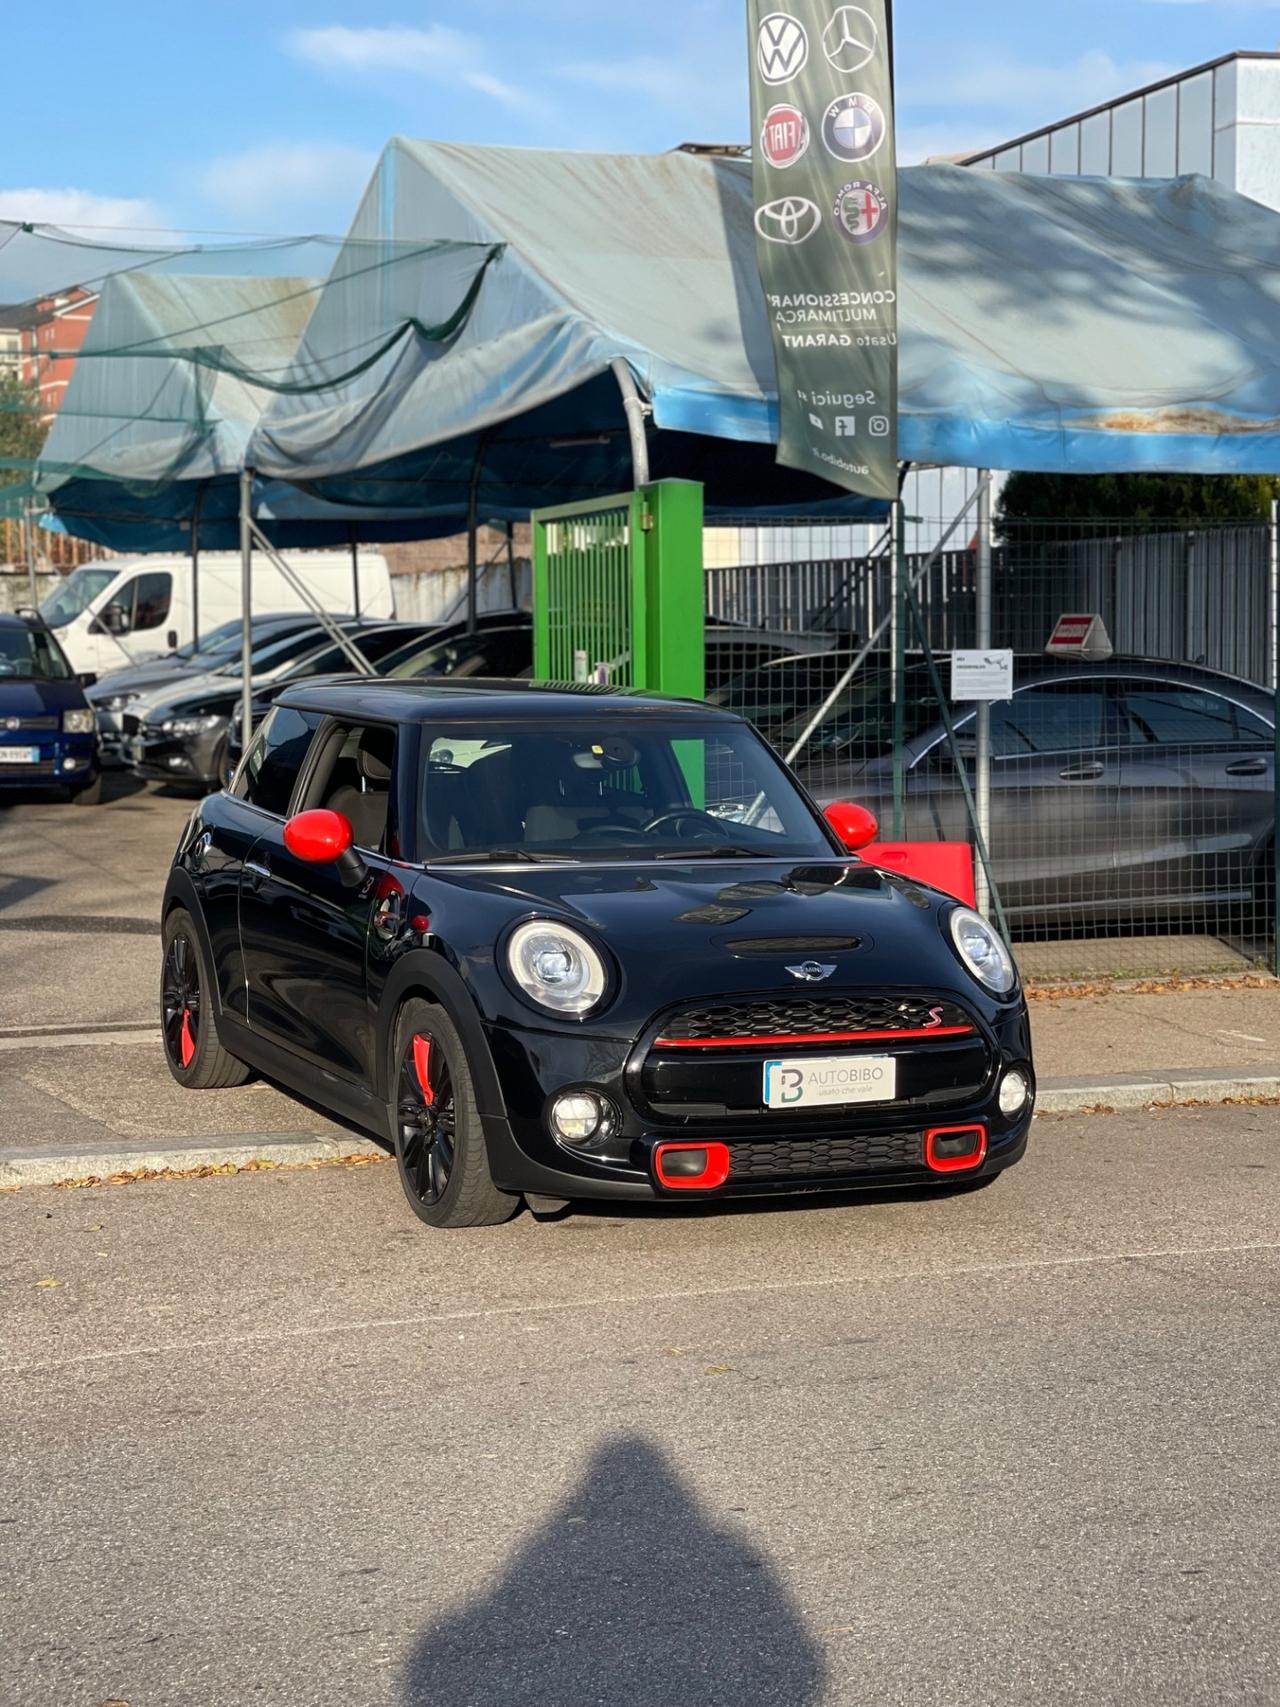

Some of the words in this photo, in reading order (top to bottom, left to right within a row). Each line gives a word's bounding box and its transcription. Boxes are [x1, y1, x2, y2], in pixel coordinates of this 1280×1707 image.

[922, 1006, 945, 1029] S
[807, 1067, 884, 1086] AUTOBIBO
[819, 1087, 840, 1096] usato
[841, 1087, 856, 1095] che
[857, 1084, 873, 1093] vale
